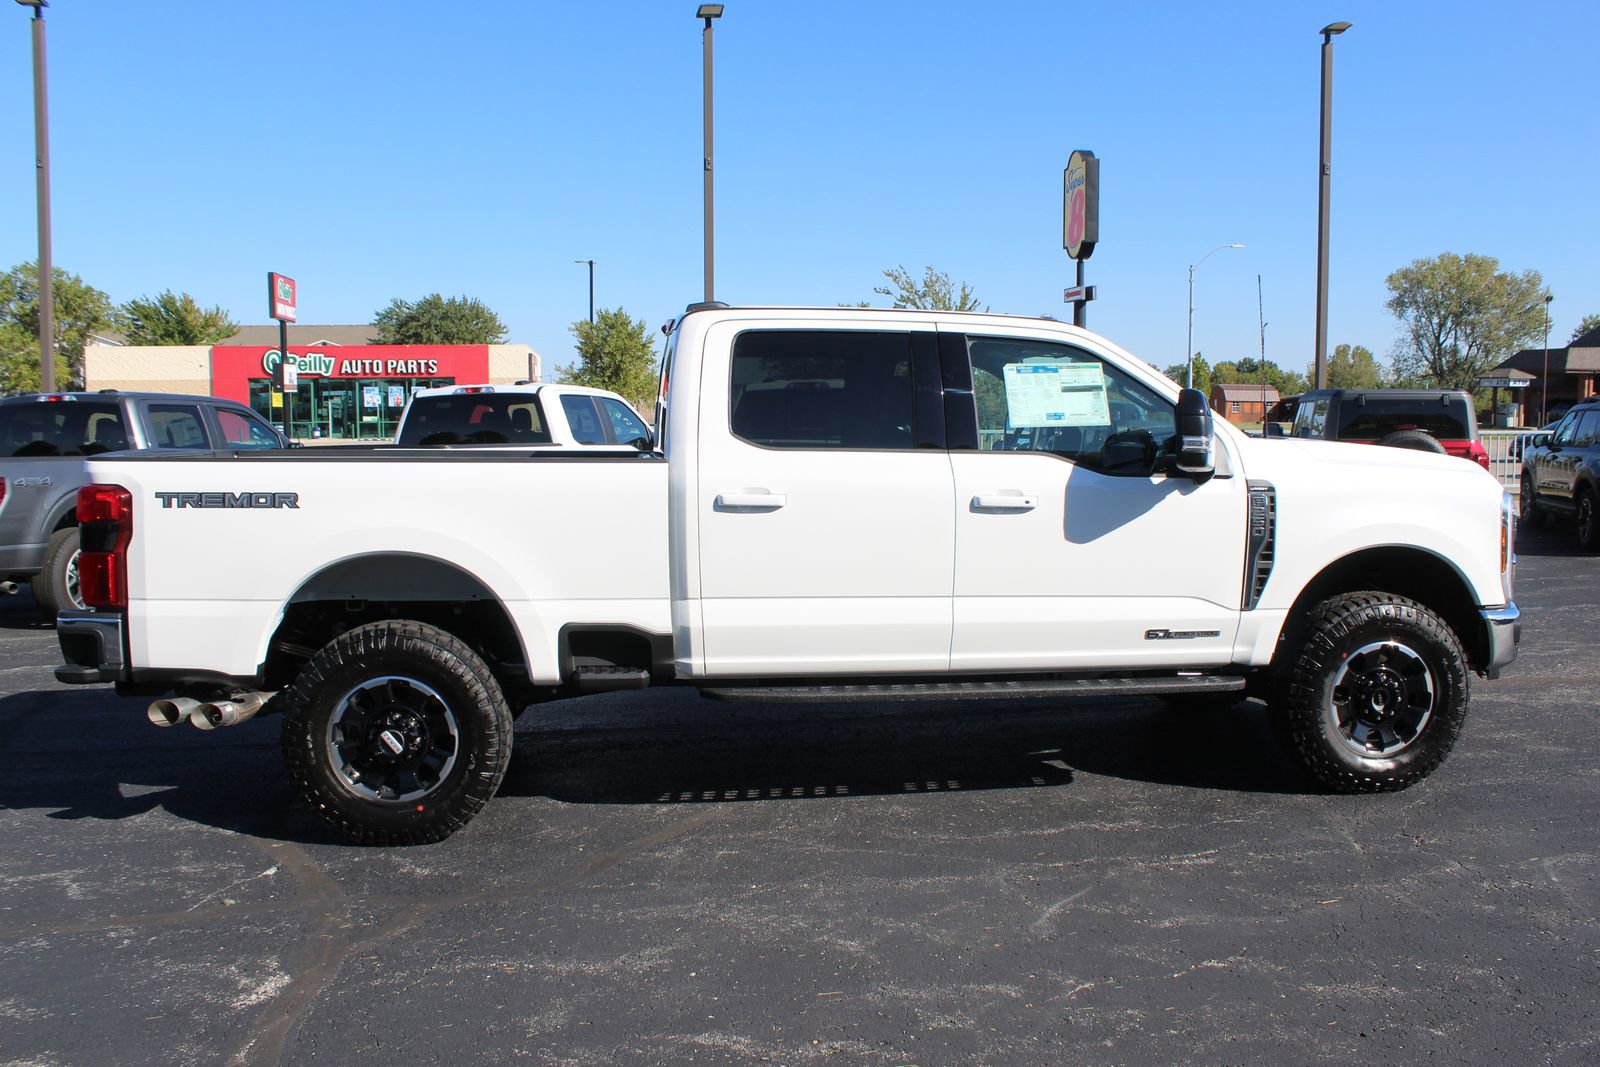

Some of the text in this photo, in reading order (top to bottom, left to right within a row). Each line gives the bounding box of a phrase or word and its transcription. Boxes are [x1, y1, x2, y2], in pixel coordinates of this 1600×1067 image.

[1068, 189, 1084, 247] 8
[340, 359, 383, 374] AUTO
[387, 359, 438, 374] PARTS
[155, 492, 300, 508] TREMOR
